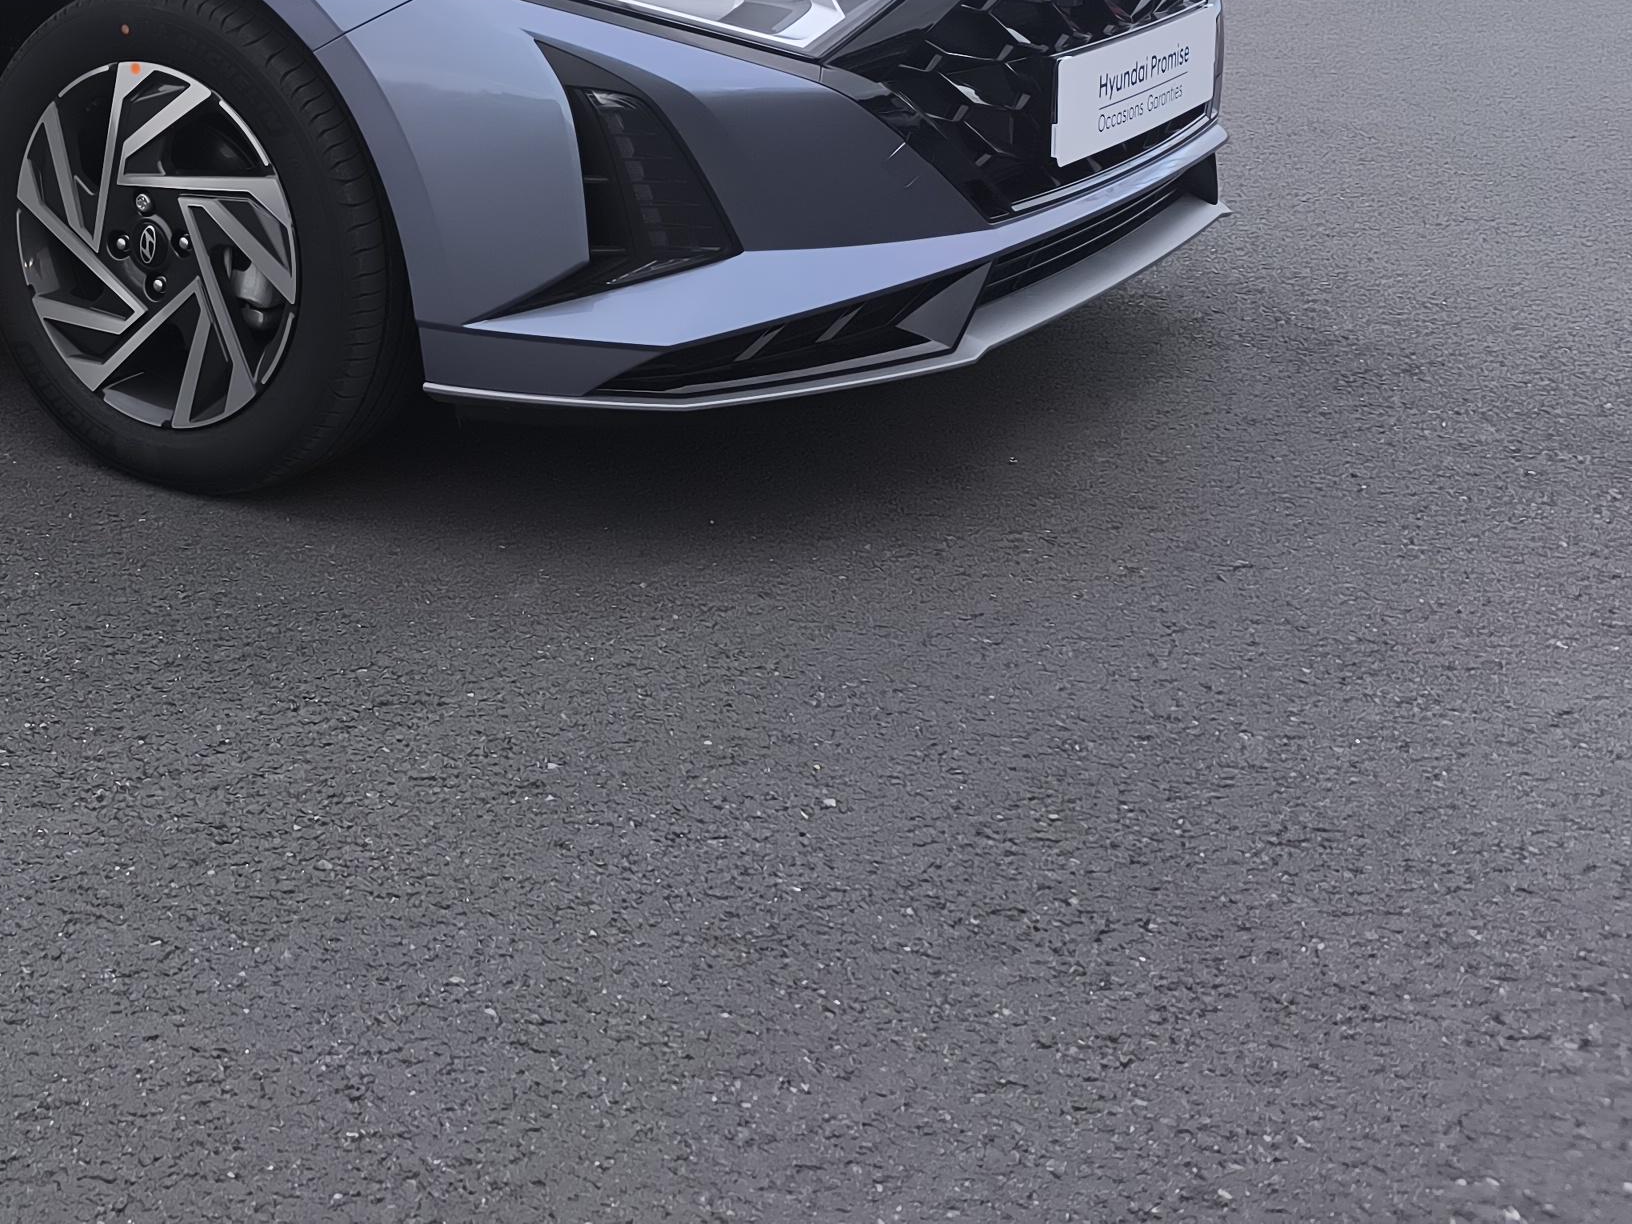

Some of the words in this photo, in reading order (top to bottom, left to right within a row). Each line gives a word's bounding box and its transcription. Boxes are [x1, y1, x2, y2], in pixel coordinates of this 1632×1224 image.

[1098, 55, 1148, 101] Hyundai
[1150, 43, 1190, 78] Promise
[1097, 102, 1144, 133] Occasions
